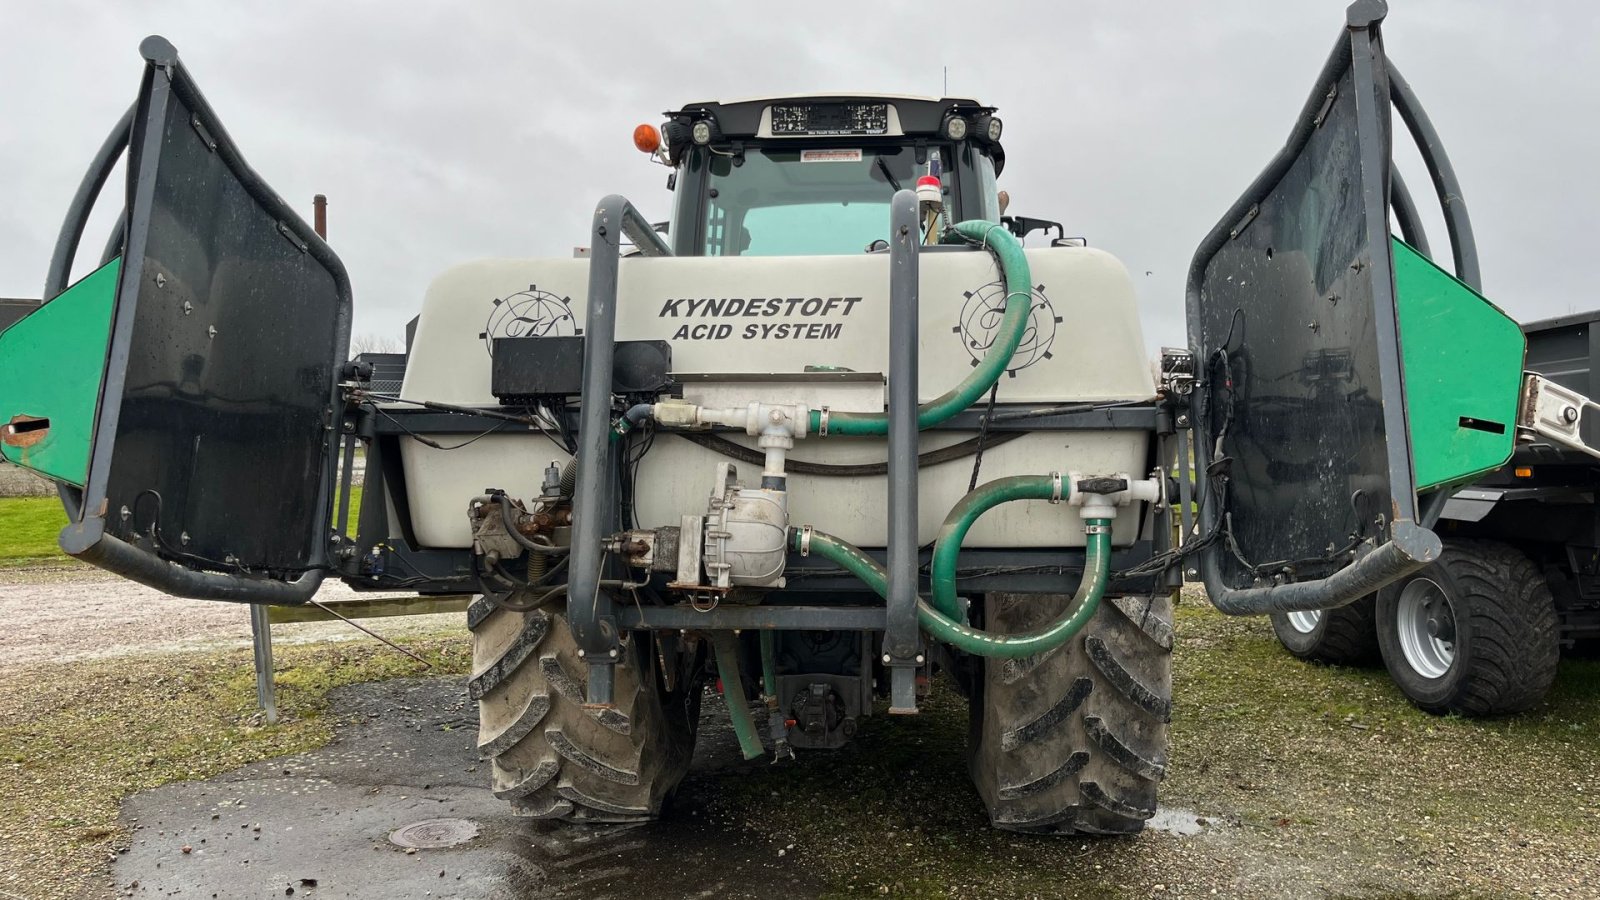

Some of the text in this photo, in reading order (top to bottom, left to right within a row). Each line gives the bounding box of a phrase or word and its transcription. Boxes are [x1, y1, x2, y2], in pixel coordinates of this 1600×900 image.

[658, 297, 863, 318] KYNDESTOFT
[672, 323, 843, 341] ACID SYSTEM
